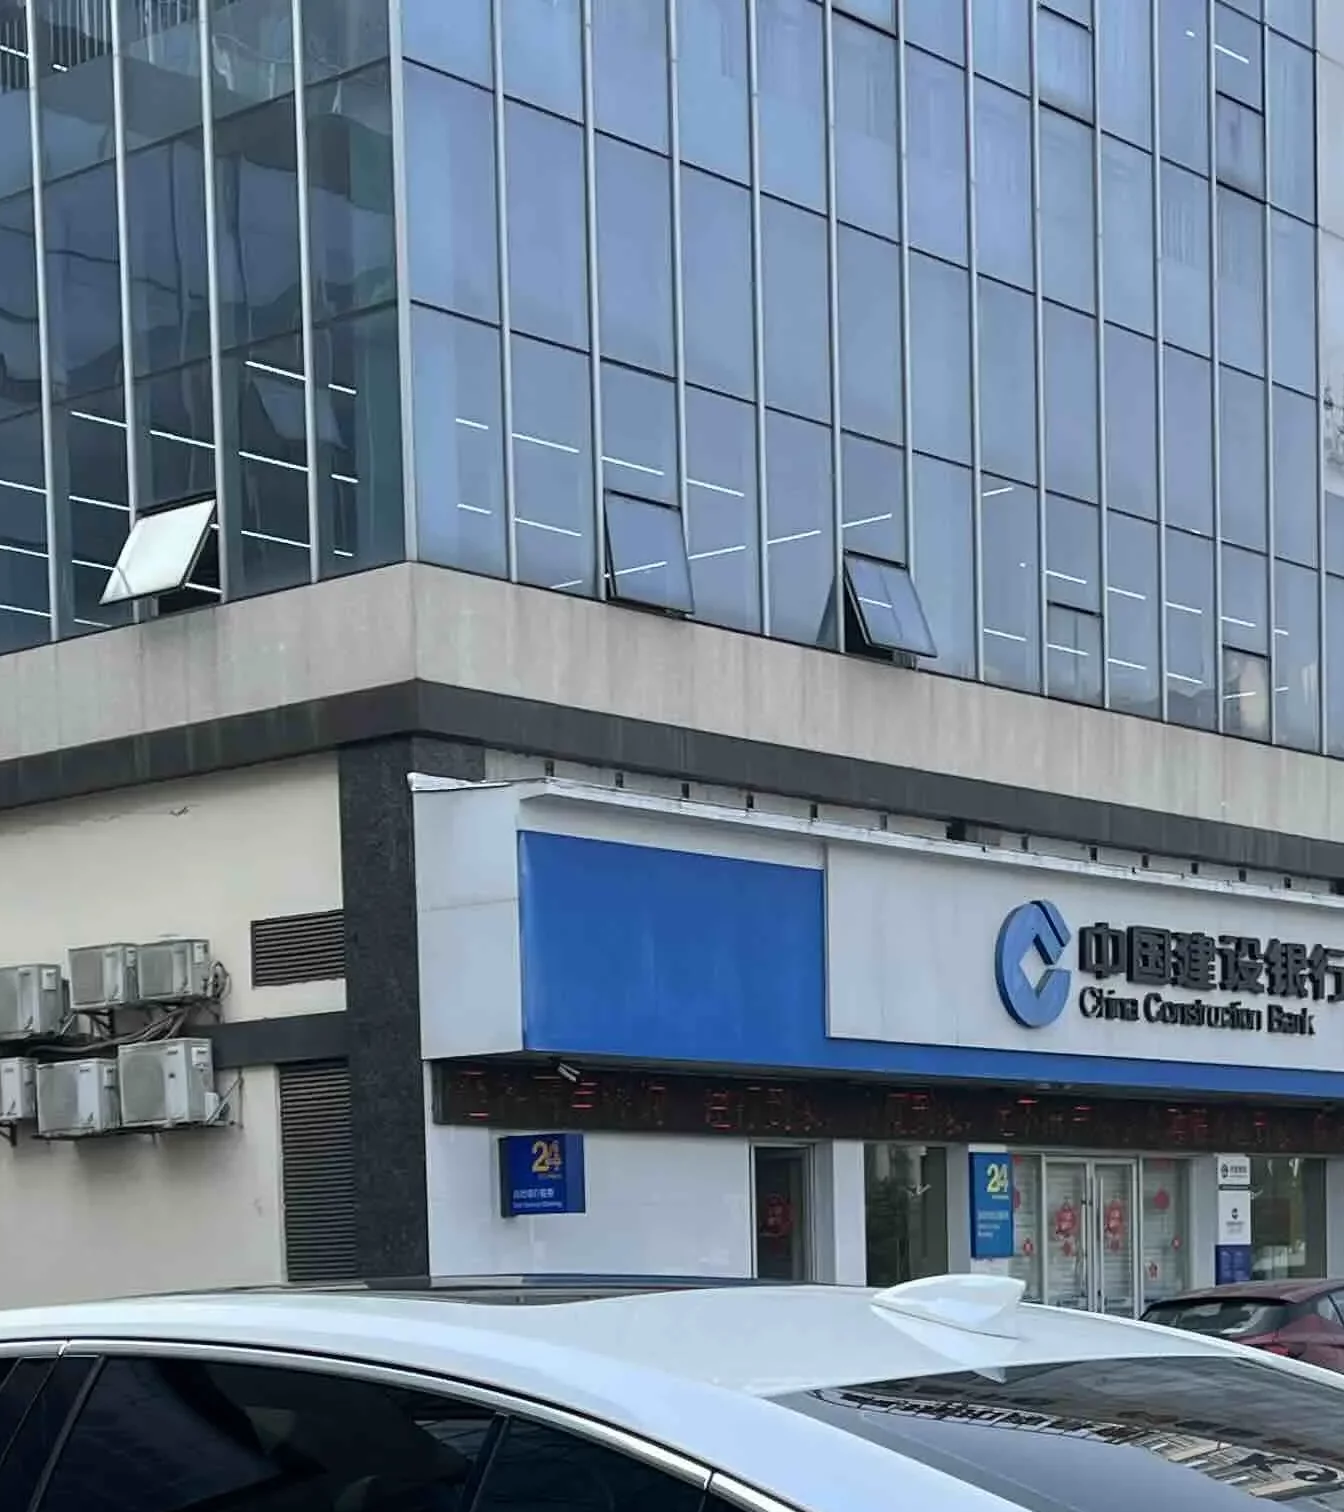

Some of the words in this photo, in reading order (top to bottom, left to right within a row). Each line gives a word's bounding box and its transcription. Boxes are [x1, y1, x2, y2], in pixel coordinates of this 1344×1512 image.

[1078, 986, 1139, 1021] China
[1143, 992, 1262, 1031] Construction
[1267, 1004, 1315, 1035] Bank
[986, 1163, 1008, 1193] 24
